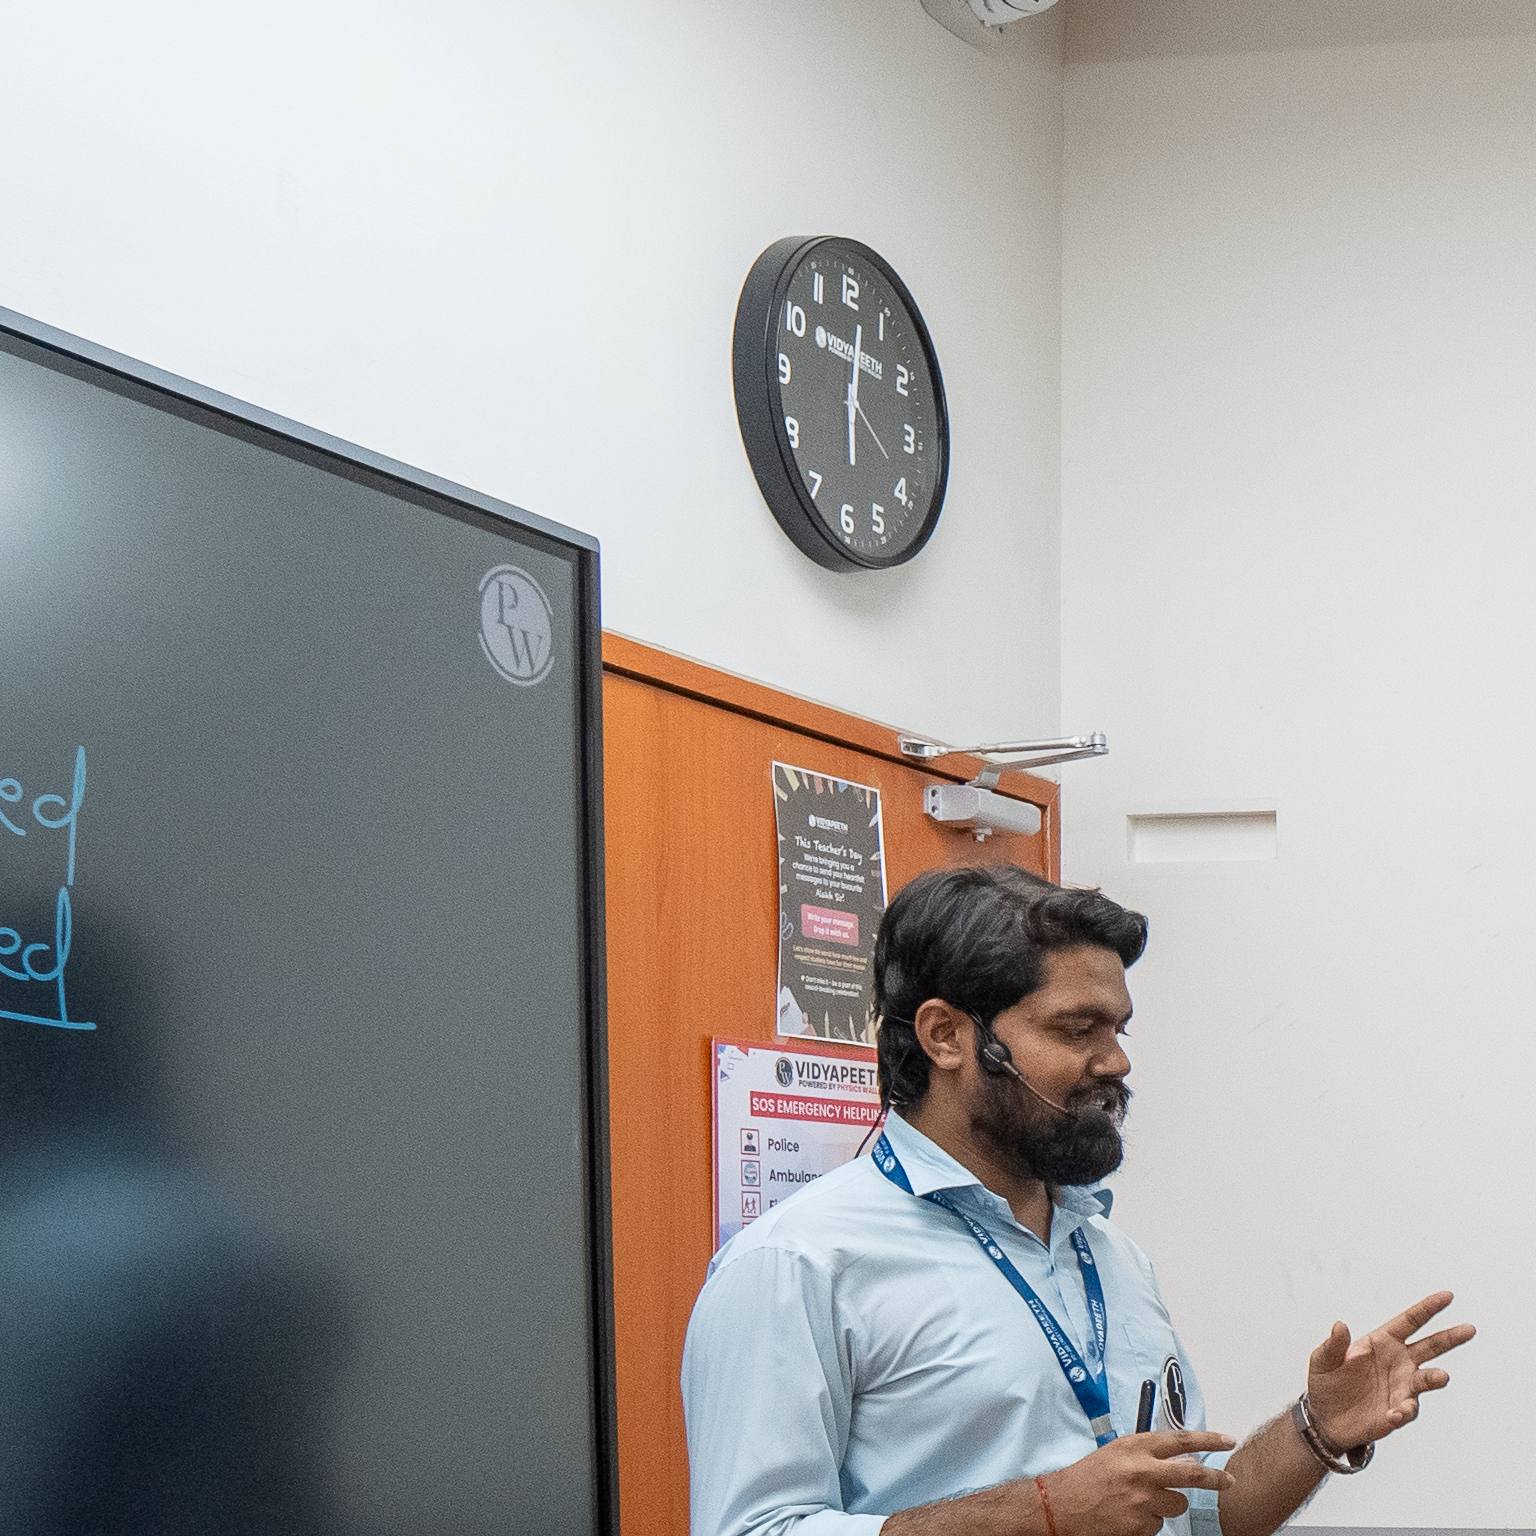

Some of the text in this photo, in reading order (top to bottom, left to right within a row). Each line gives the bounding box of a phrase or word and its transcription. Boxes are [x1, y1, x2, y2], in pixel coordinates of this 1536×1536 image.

[813, 271, 824, 305] 11
[842, 273, 860, 312] 12
[786, 300, 807, 338] 10
[878, 312, 885, 341] 1
[778, 352, 792, 385] 9
[826, 332, 882, 375] VIDYAEETH
[895, 363, 909, 397] 2
[784, 415, 800, 449] 8
[903, 423, 915, 455] 3
[808, 469, 823, 500] 7
[893, 477, 908, 506] 4
[840, 503, 855, 535] 6
[871, 502, 885, 535] 5
[752, 1097, 775, 1113] SOS
[777, 1099, 842, 1119] EMERGENCY
[767, 1138, 800, 1153] Police
